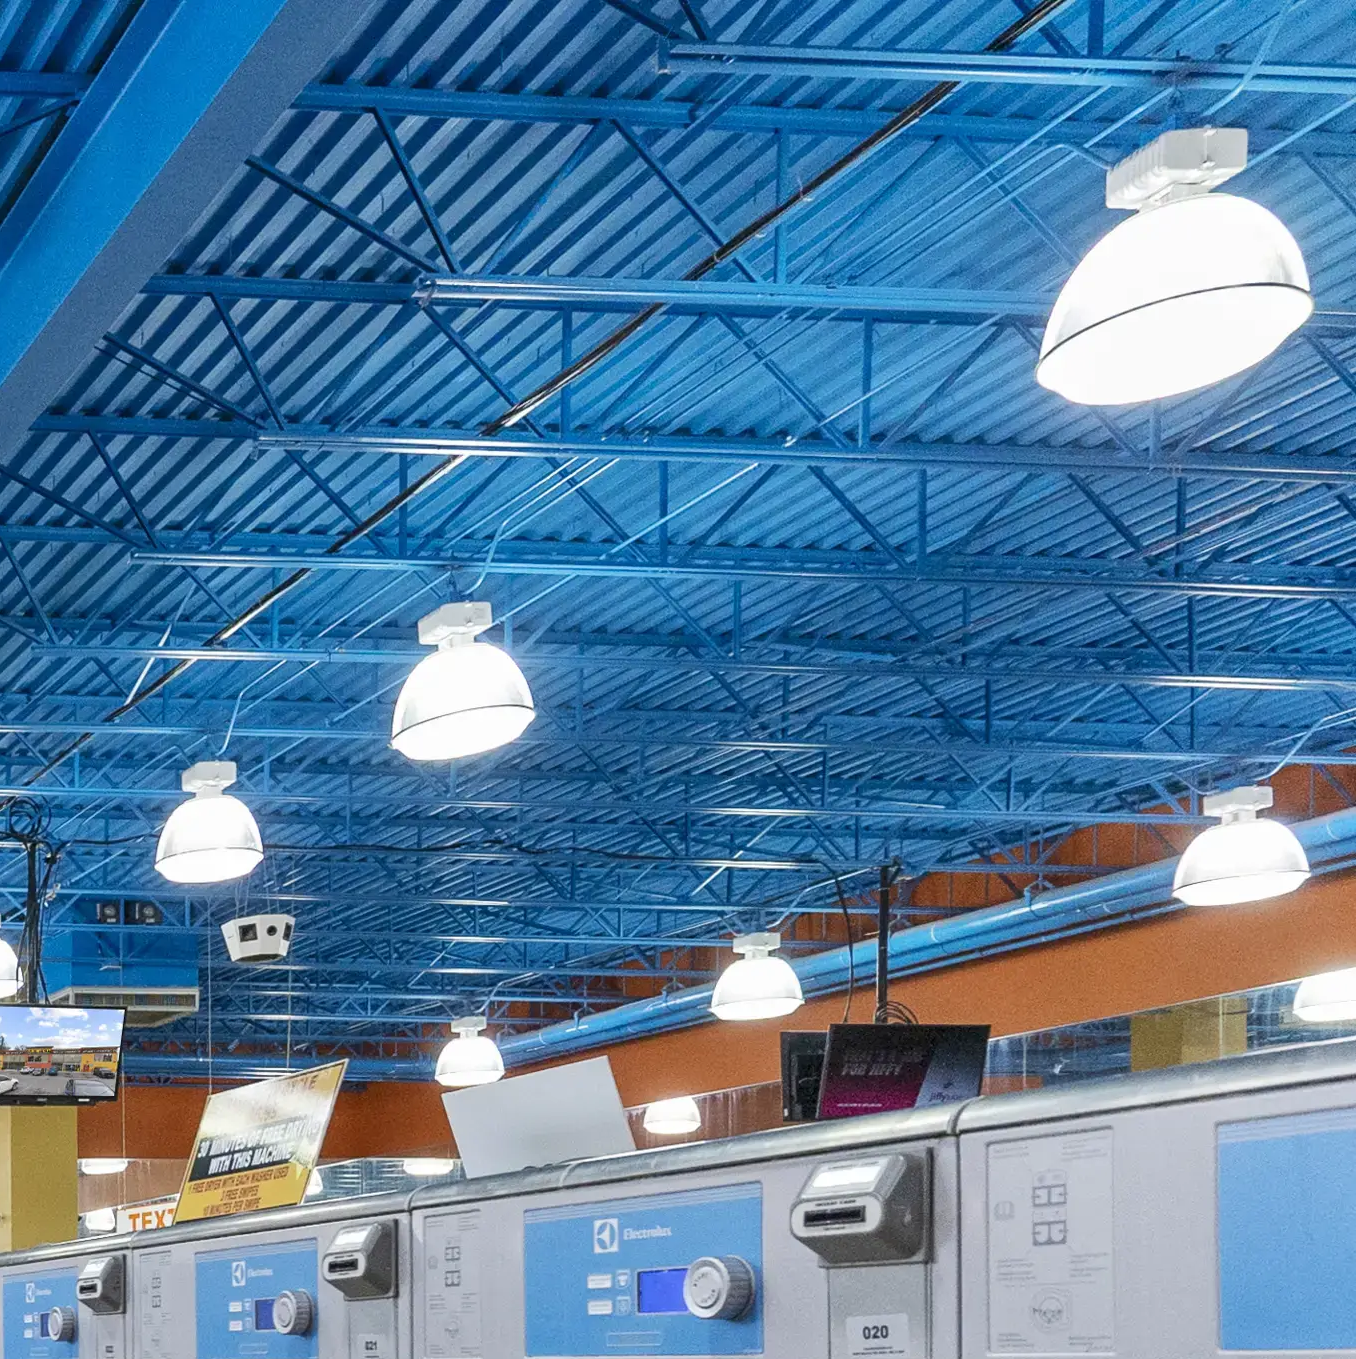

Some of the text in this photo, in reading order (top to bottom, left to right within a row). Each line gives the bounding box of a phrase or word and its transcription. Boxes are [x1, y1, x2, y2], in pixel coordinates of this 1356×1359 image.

[209, 1136, 246, 1156] MINUTES
[208, 1154, 232, 1175] WITH
[231, 1150, 253, 1170] THIS
[863, 1325, 889, 1340] 020
